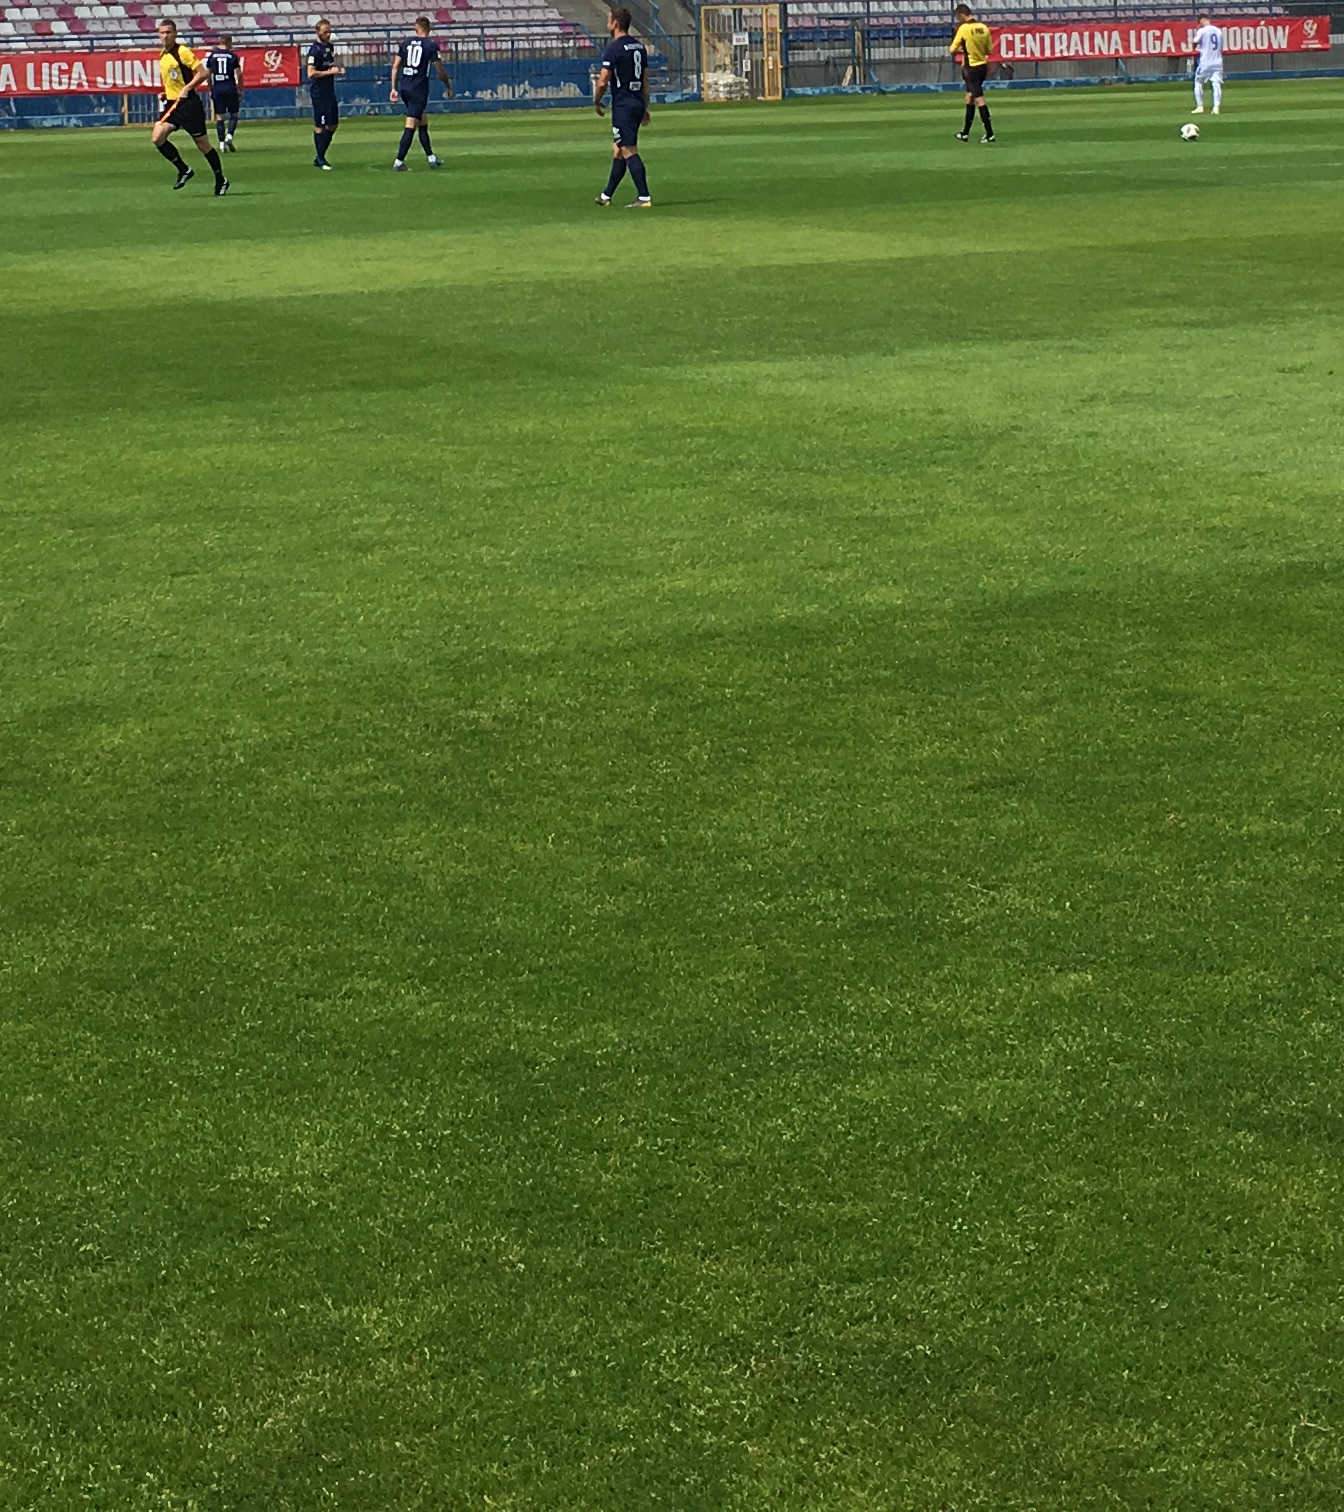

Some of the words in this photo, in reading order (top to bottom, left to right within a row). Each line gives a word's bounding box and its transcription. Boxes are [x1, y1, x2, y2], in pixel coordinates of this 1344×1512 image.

[999, 29, 1125, 59] CENTRALNA
[1129, 28, 1176, 56] LIGA
[1181, 20, 1290, 53] JIORÓW
[1210, 33, 1219, 51] 9
[216, 57, 228, 74] 11
[406, 45, 423, 68] 10
[633, 50, 643, 80] 8
[26, 61, 89, 91] LIGA
